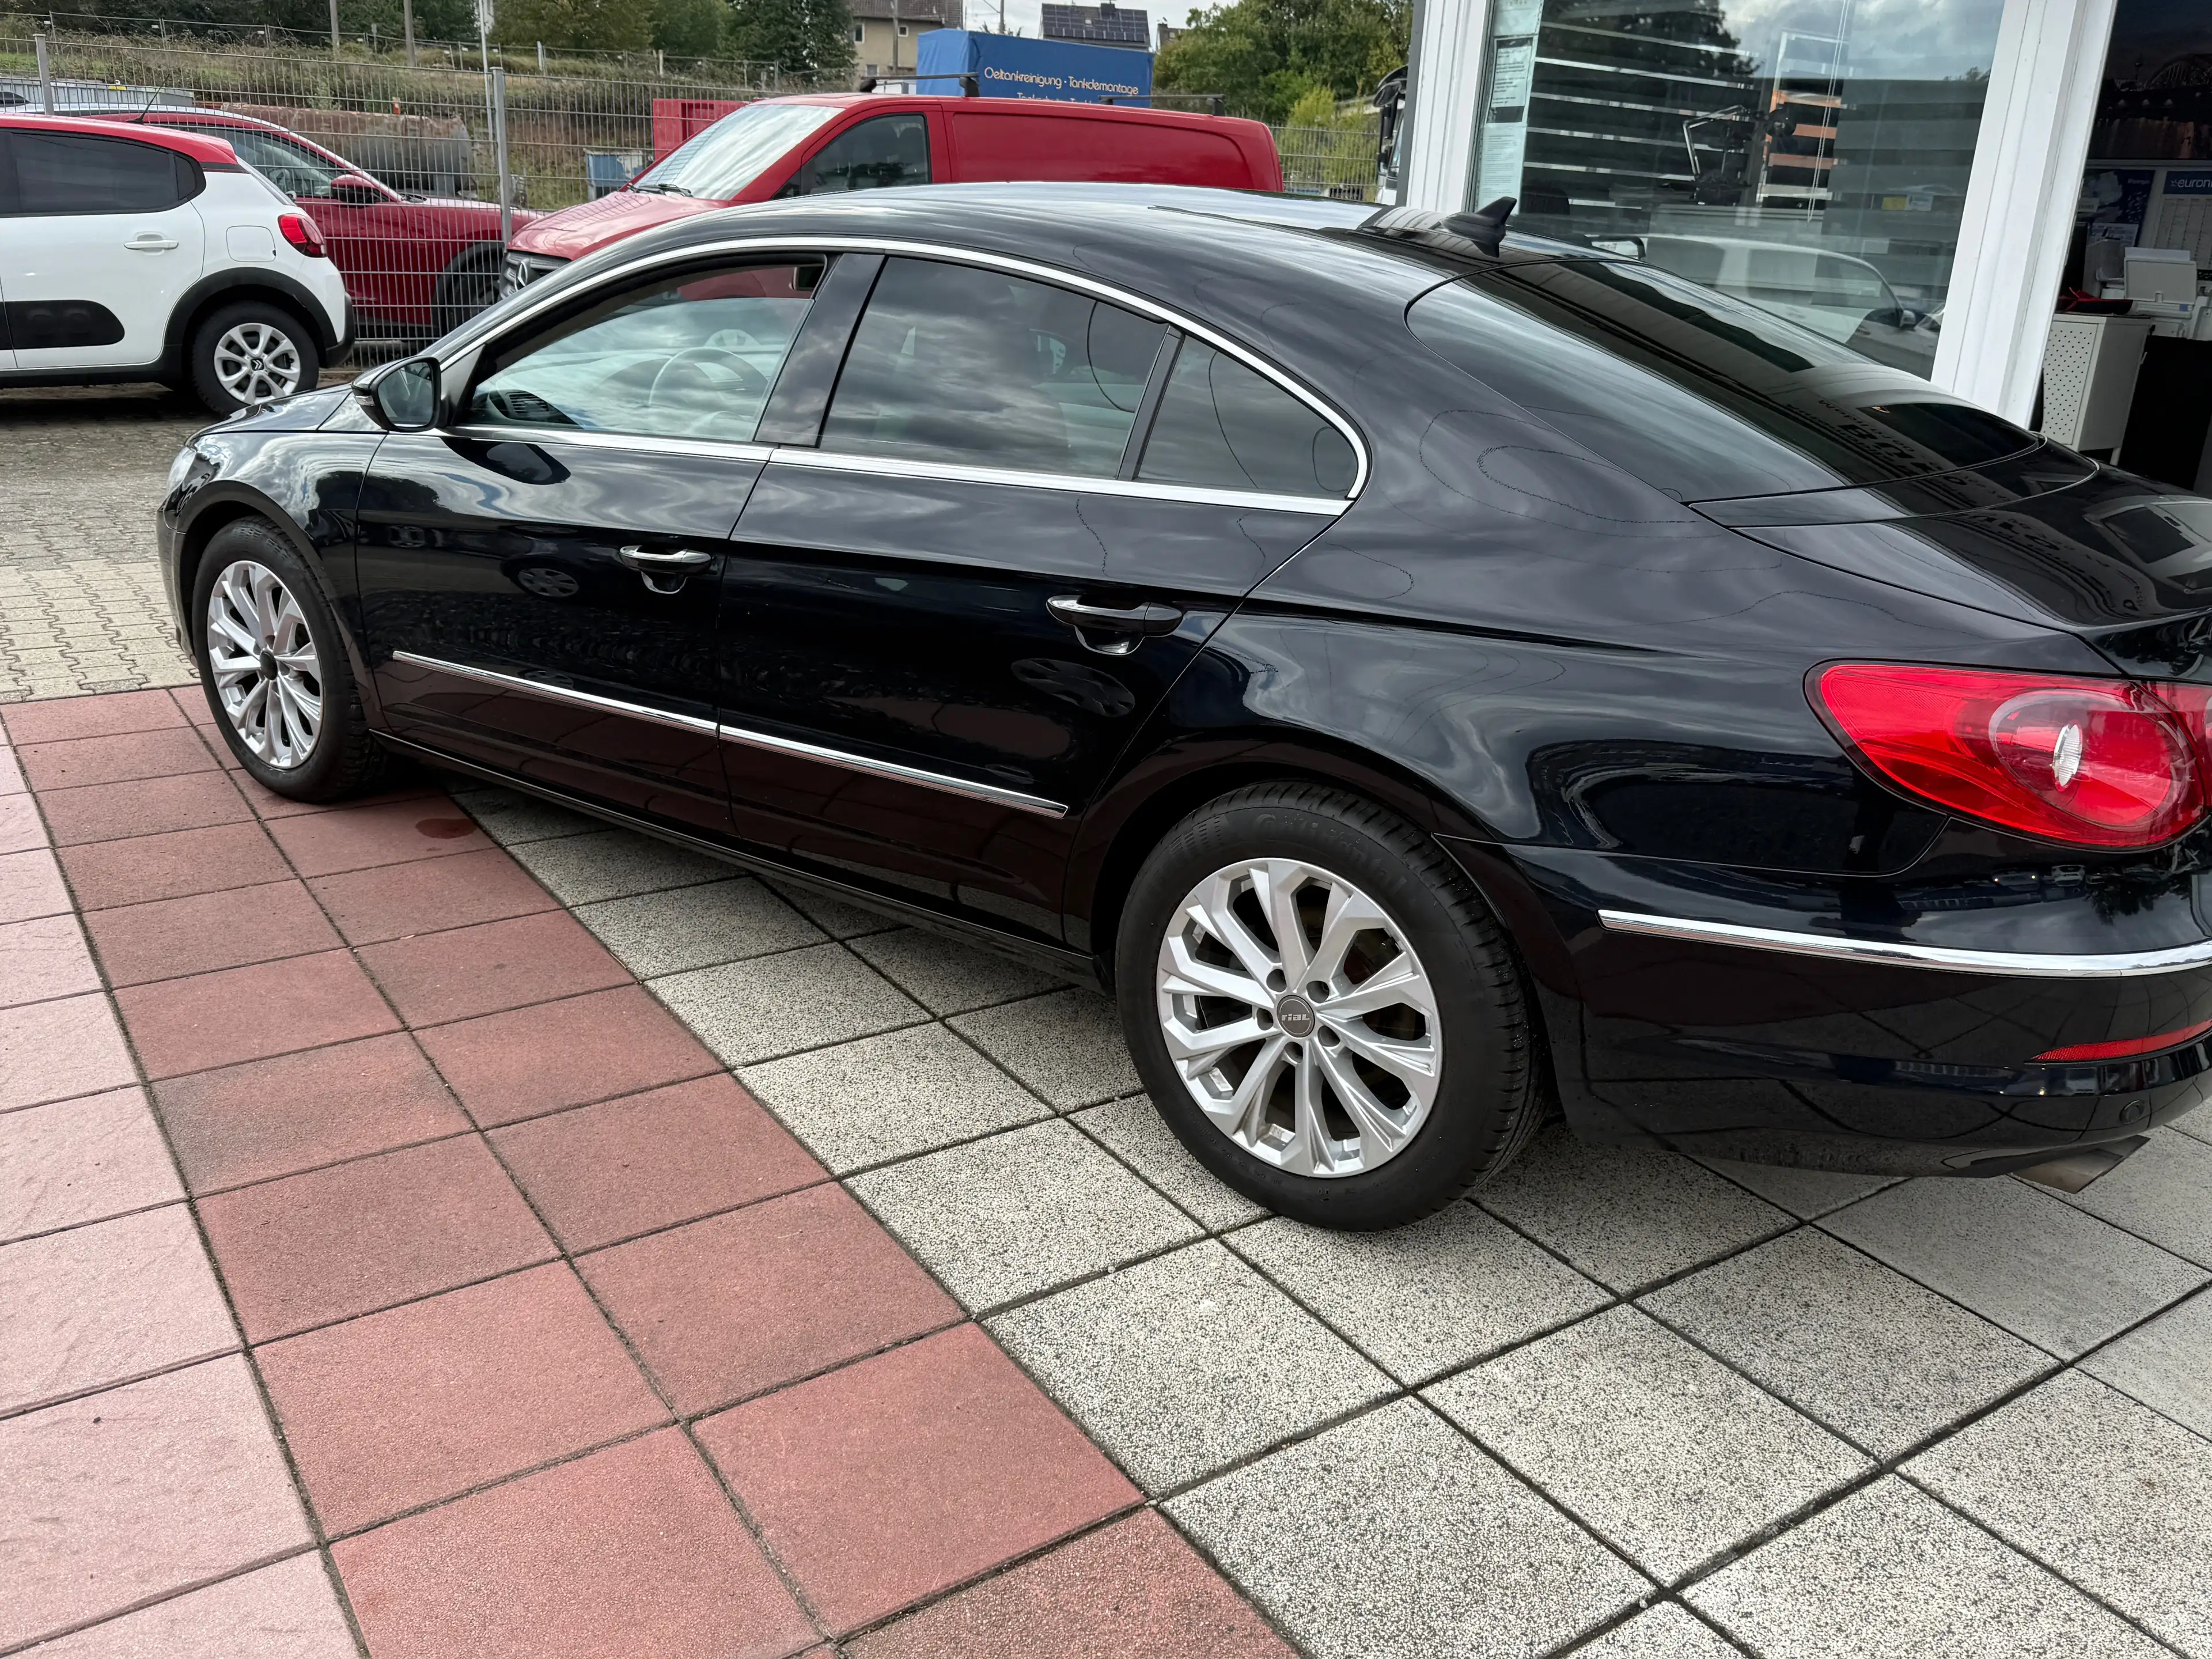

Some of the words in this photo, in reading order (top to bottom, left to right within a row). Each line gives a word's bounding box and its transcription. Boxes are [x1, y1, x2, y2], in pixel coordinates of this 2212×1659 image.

[984, 66, 1062, 89] Oeltankreinigung
[1067, 75, 1139, 94] Tankdemontage
[2177, 178, 2212, 188] euron
